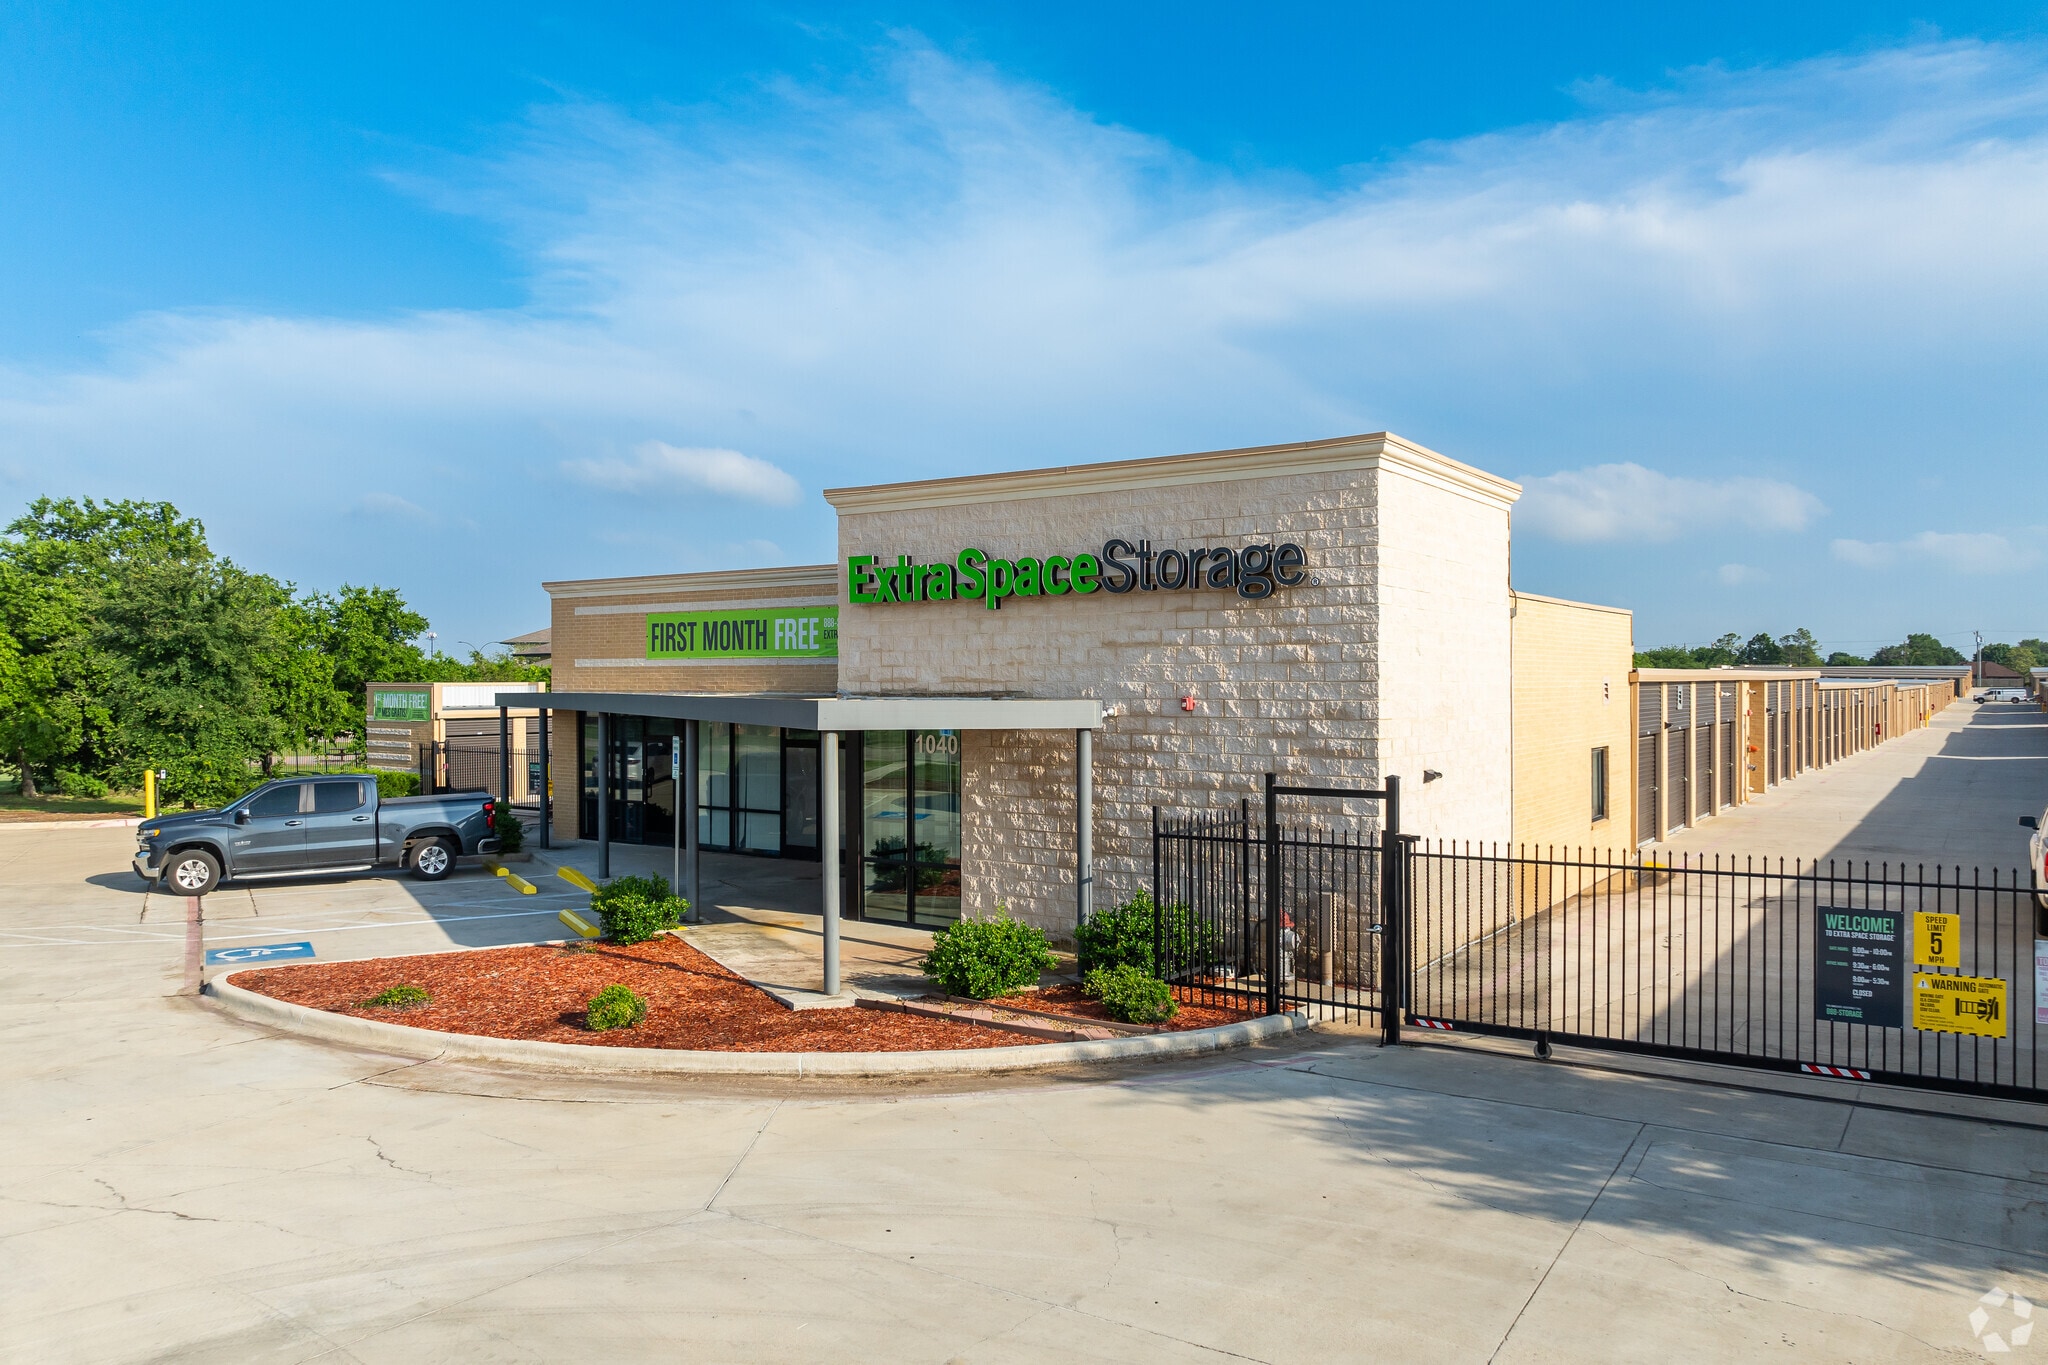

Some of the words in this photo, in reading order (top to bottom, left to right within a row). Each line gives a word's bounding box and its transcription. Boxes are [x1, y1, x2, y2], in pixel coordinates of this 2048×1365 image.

[824, 617, 838, 628] 888-
[651, 622, 697, 652] FIRST
[703, 619, 767, 651] MONTH
[774, 617, 819, 650] FREE
[384, 693, 408, 709] MONTH
[915, 734, 958, 755] 1040
[1825, 913, 1895, 934] WELCOME!
[1925, 915, 1948, 925] SPEED
[1926, 923, 1946, 932] LIMIT
[1825, 929, 1833, 937] TO
[1851, 932, 1869, 940] SPACE
[1869, 933, 1895, 942] STORAGE
[1930, 931, 1943, 955] 5
[1928, 955, 1945, 964] MPH
[1931, 978, 1976, 993] WARNING
[1852, 989, 1873, 997] CLOSED
